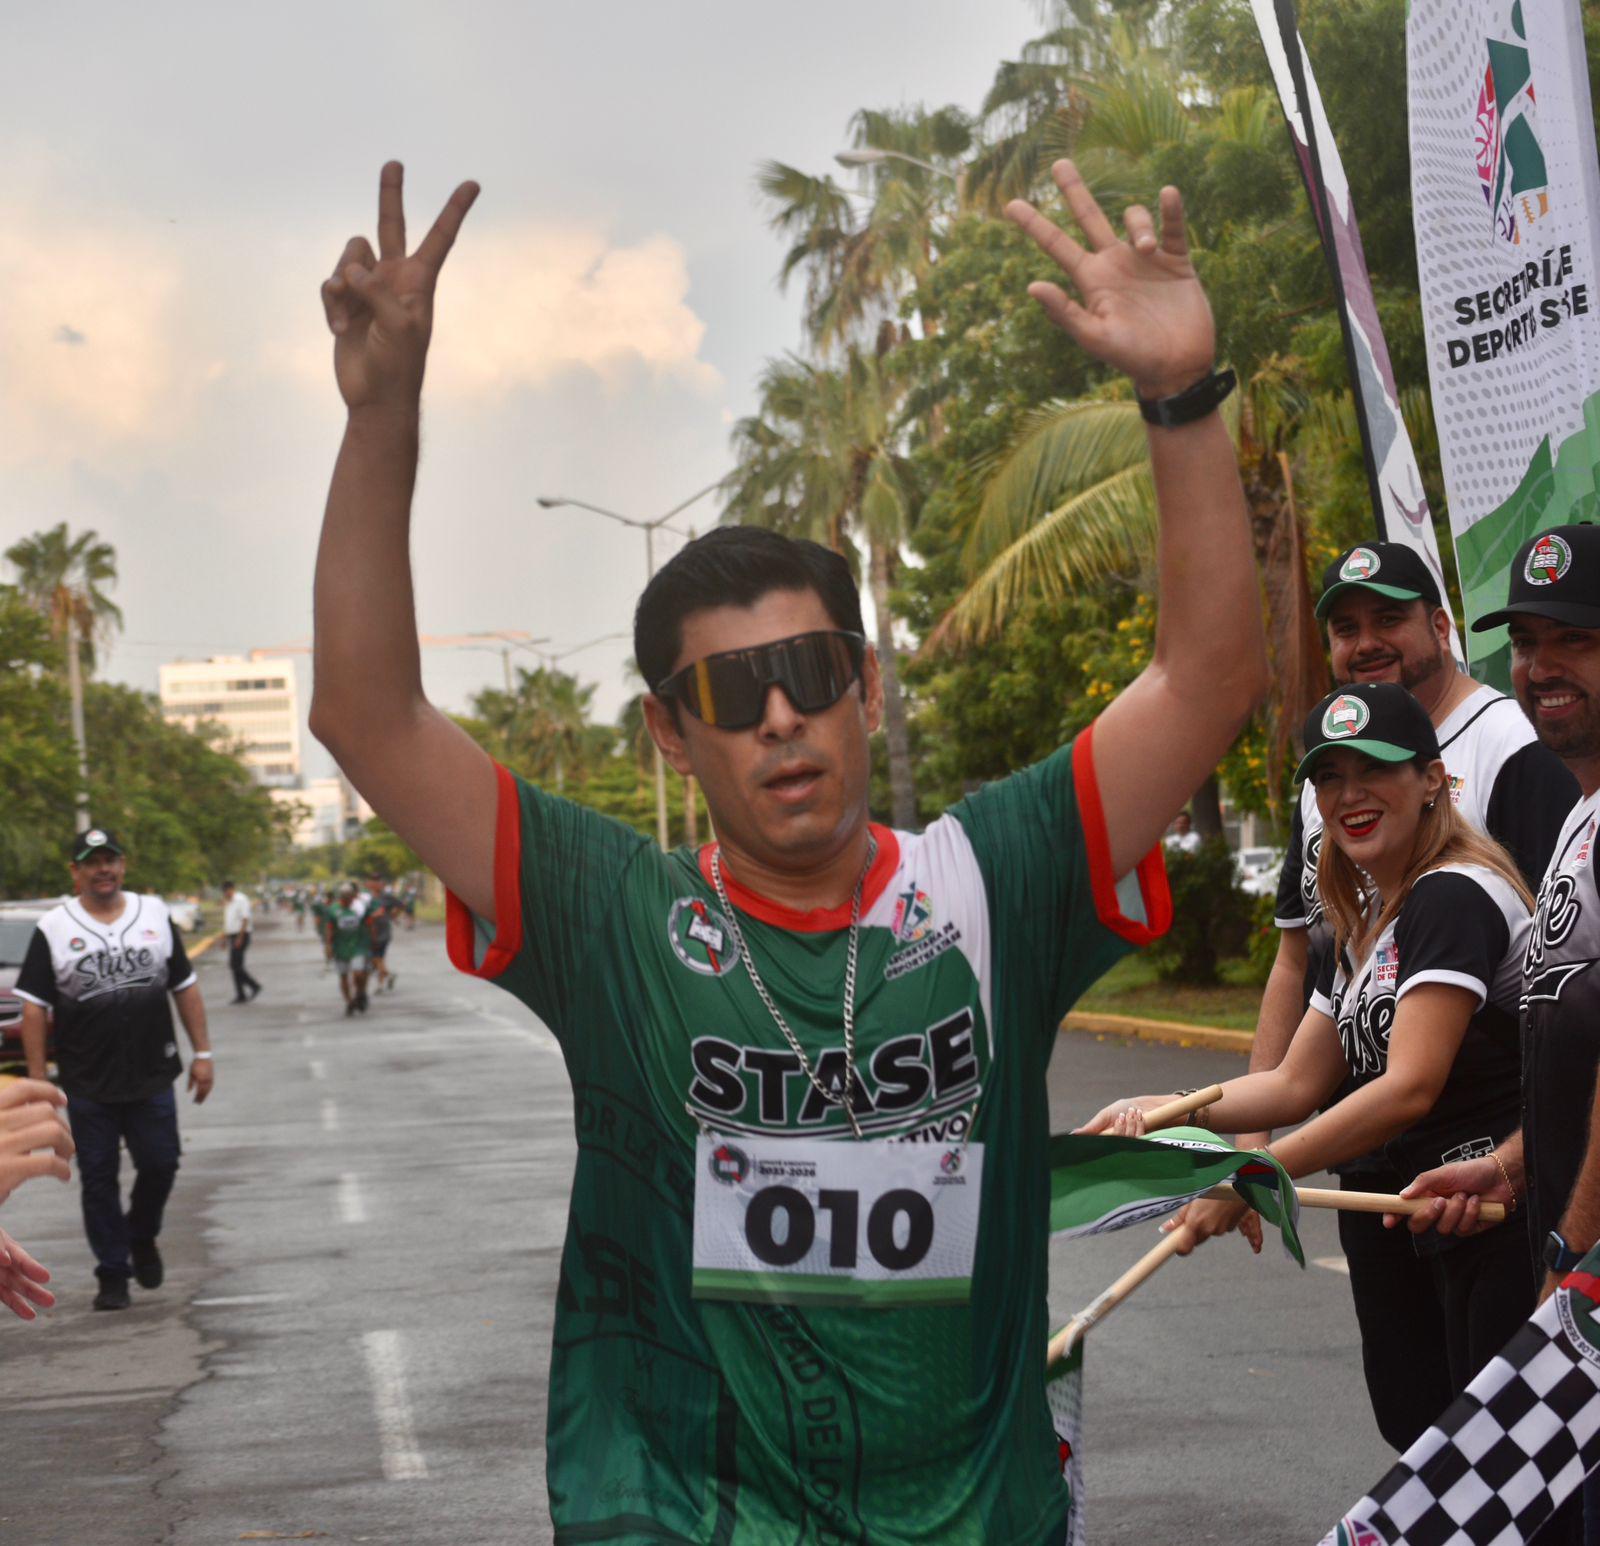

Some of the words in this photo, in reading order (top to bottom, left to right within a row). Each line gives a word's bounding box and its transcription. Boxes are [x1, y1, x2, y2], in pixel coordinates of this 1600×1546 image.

[76, 946, 155, 989] Stuse
[689, 1006, 978, 1125] STASE
[745, 1185, 934, 1270] 010
